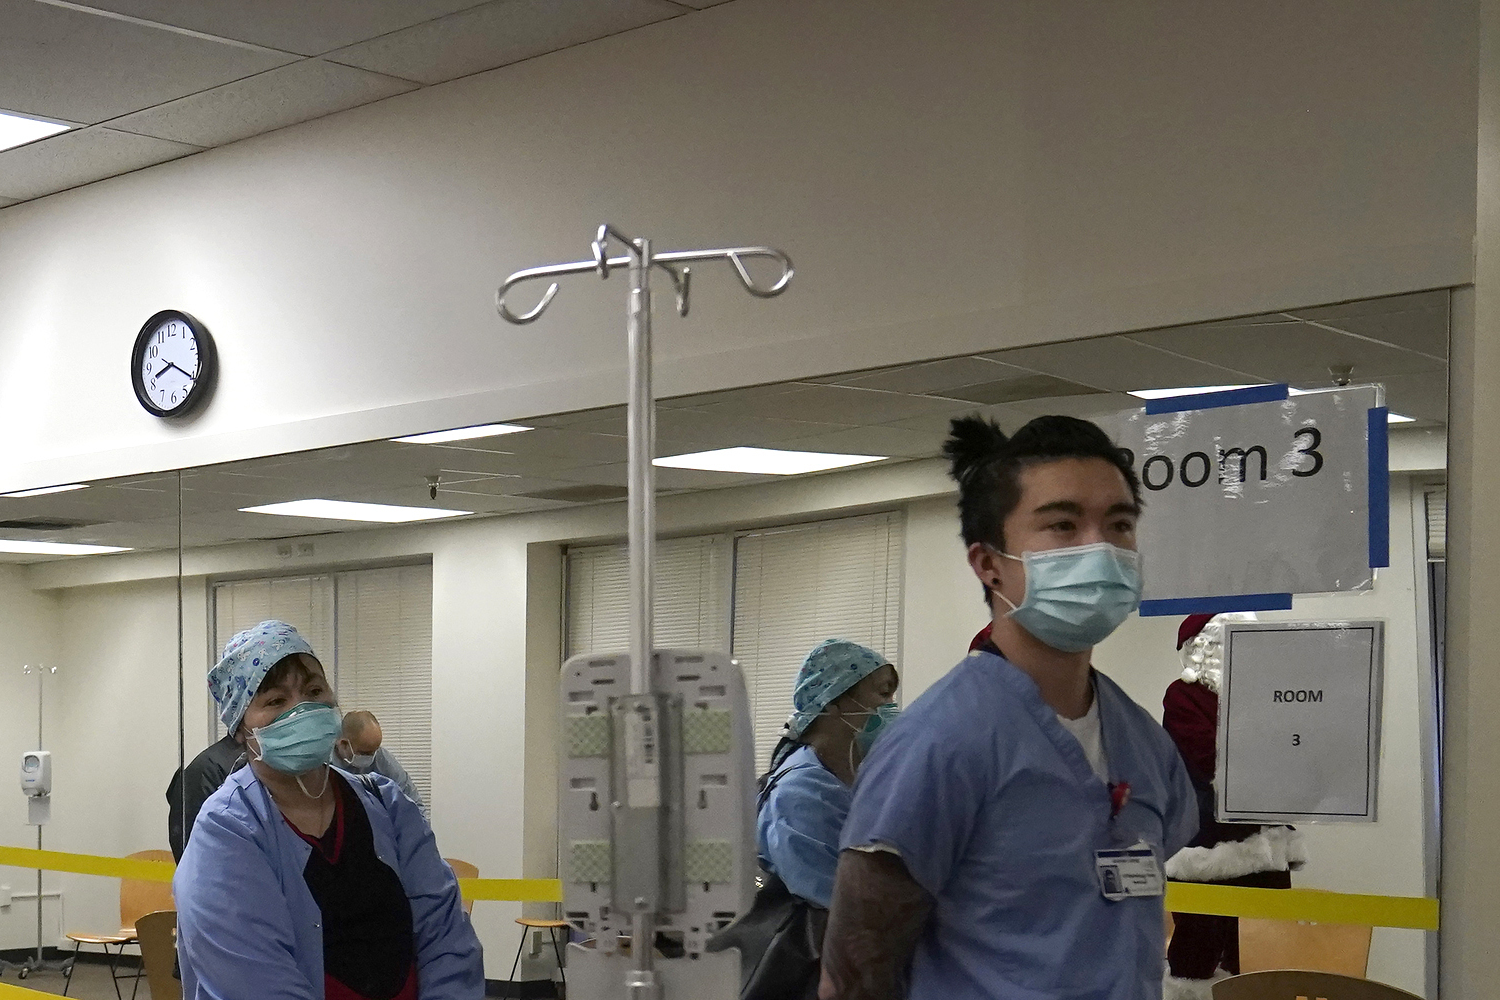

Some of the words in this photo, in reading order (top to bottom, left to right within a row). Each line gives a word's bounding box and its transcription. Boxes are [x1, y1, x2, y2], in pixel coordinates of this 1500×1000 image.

[167, 324, 176, 337] 12
[182, 327, 185, 339] 1
[158, 331, 164, 344] 11
[149, 345, 158, 358] 10
[146, 362, 152, 375] 9
[150, 378, 156, 391] 8
[160, 390, 165, 402] 7
[171, 390, 177, 404] 6
[183, 385, 188, 398] 5
[1116, 444, 1268, 491] oom
[1291, 426, 1324, 478] 3
[1273, 689, 1323, 703] ROOM
[1291, 733, 1301, 747] 3
